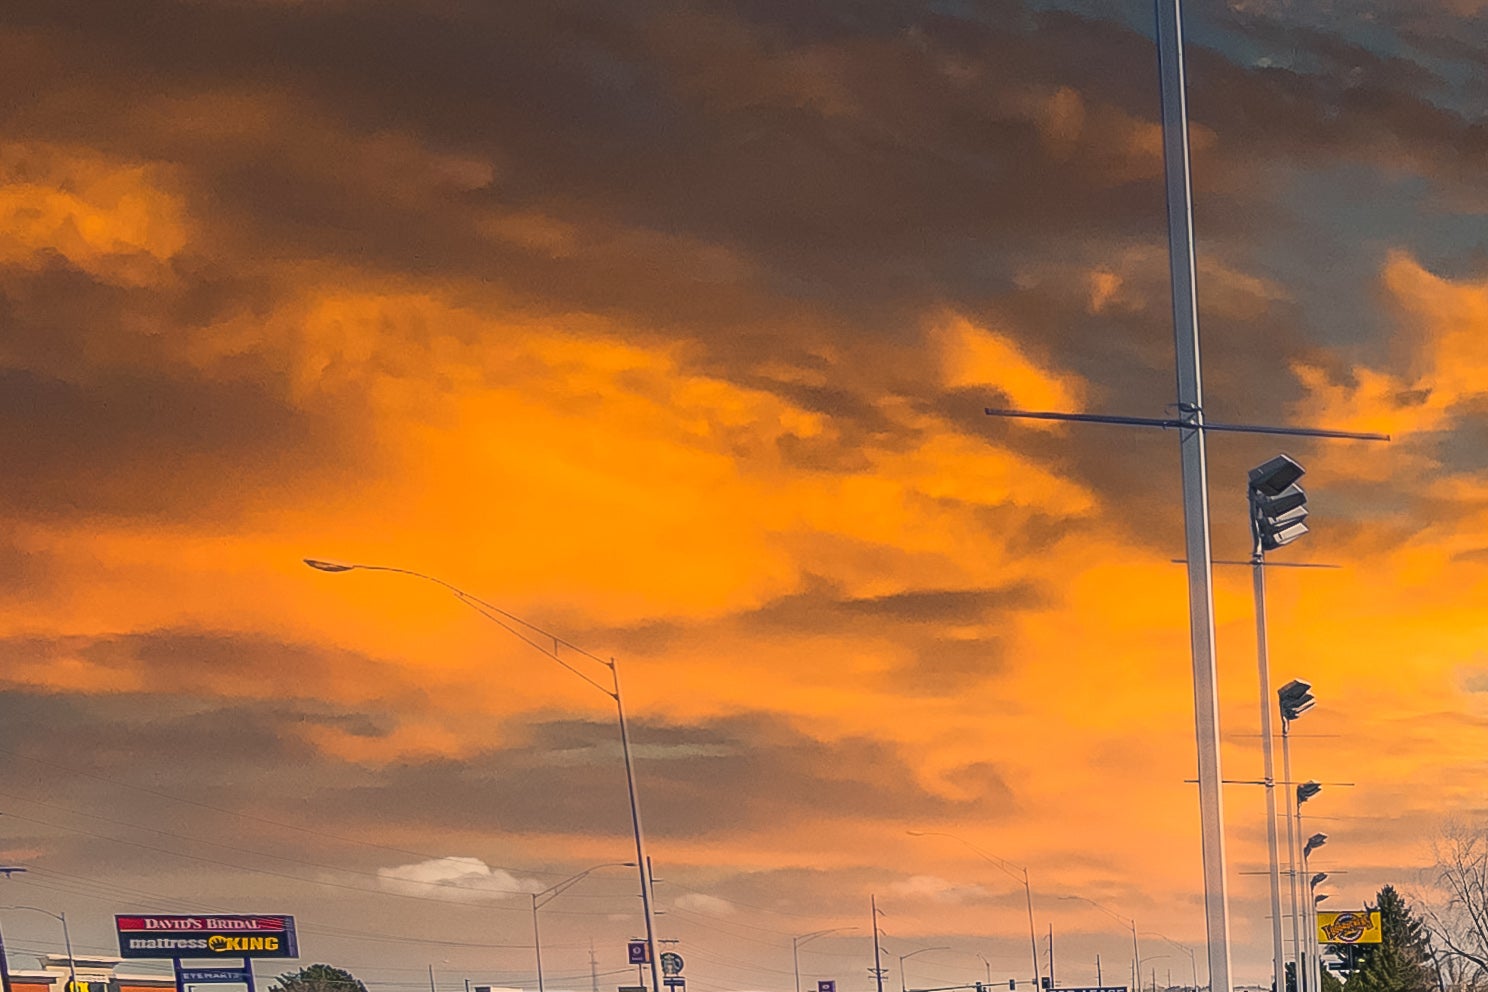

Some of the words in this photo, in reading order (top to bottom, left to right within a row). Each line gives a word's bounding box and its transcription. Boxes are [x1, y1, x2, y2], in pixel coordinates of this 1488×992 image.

[144, 917, 202, 929] DAVID'S
[206, 917, 260, 929] BRIDAL
[129, 935, 208, 949] mattress
[226, 937, 279, 950] KING
